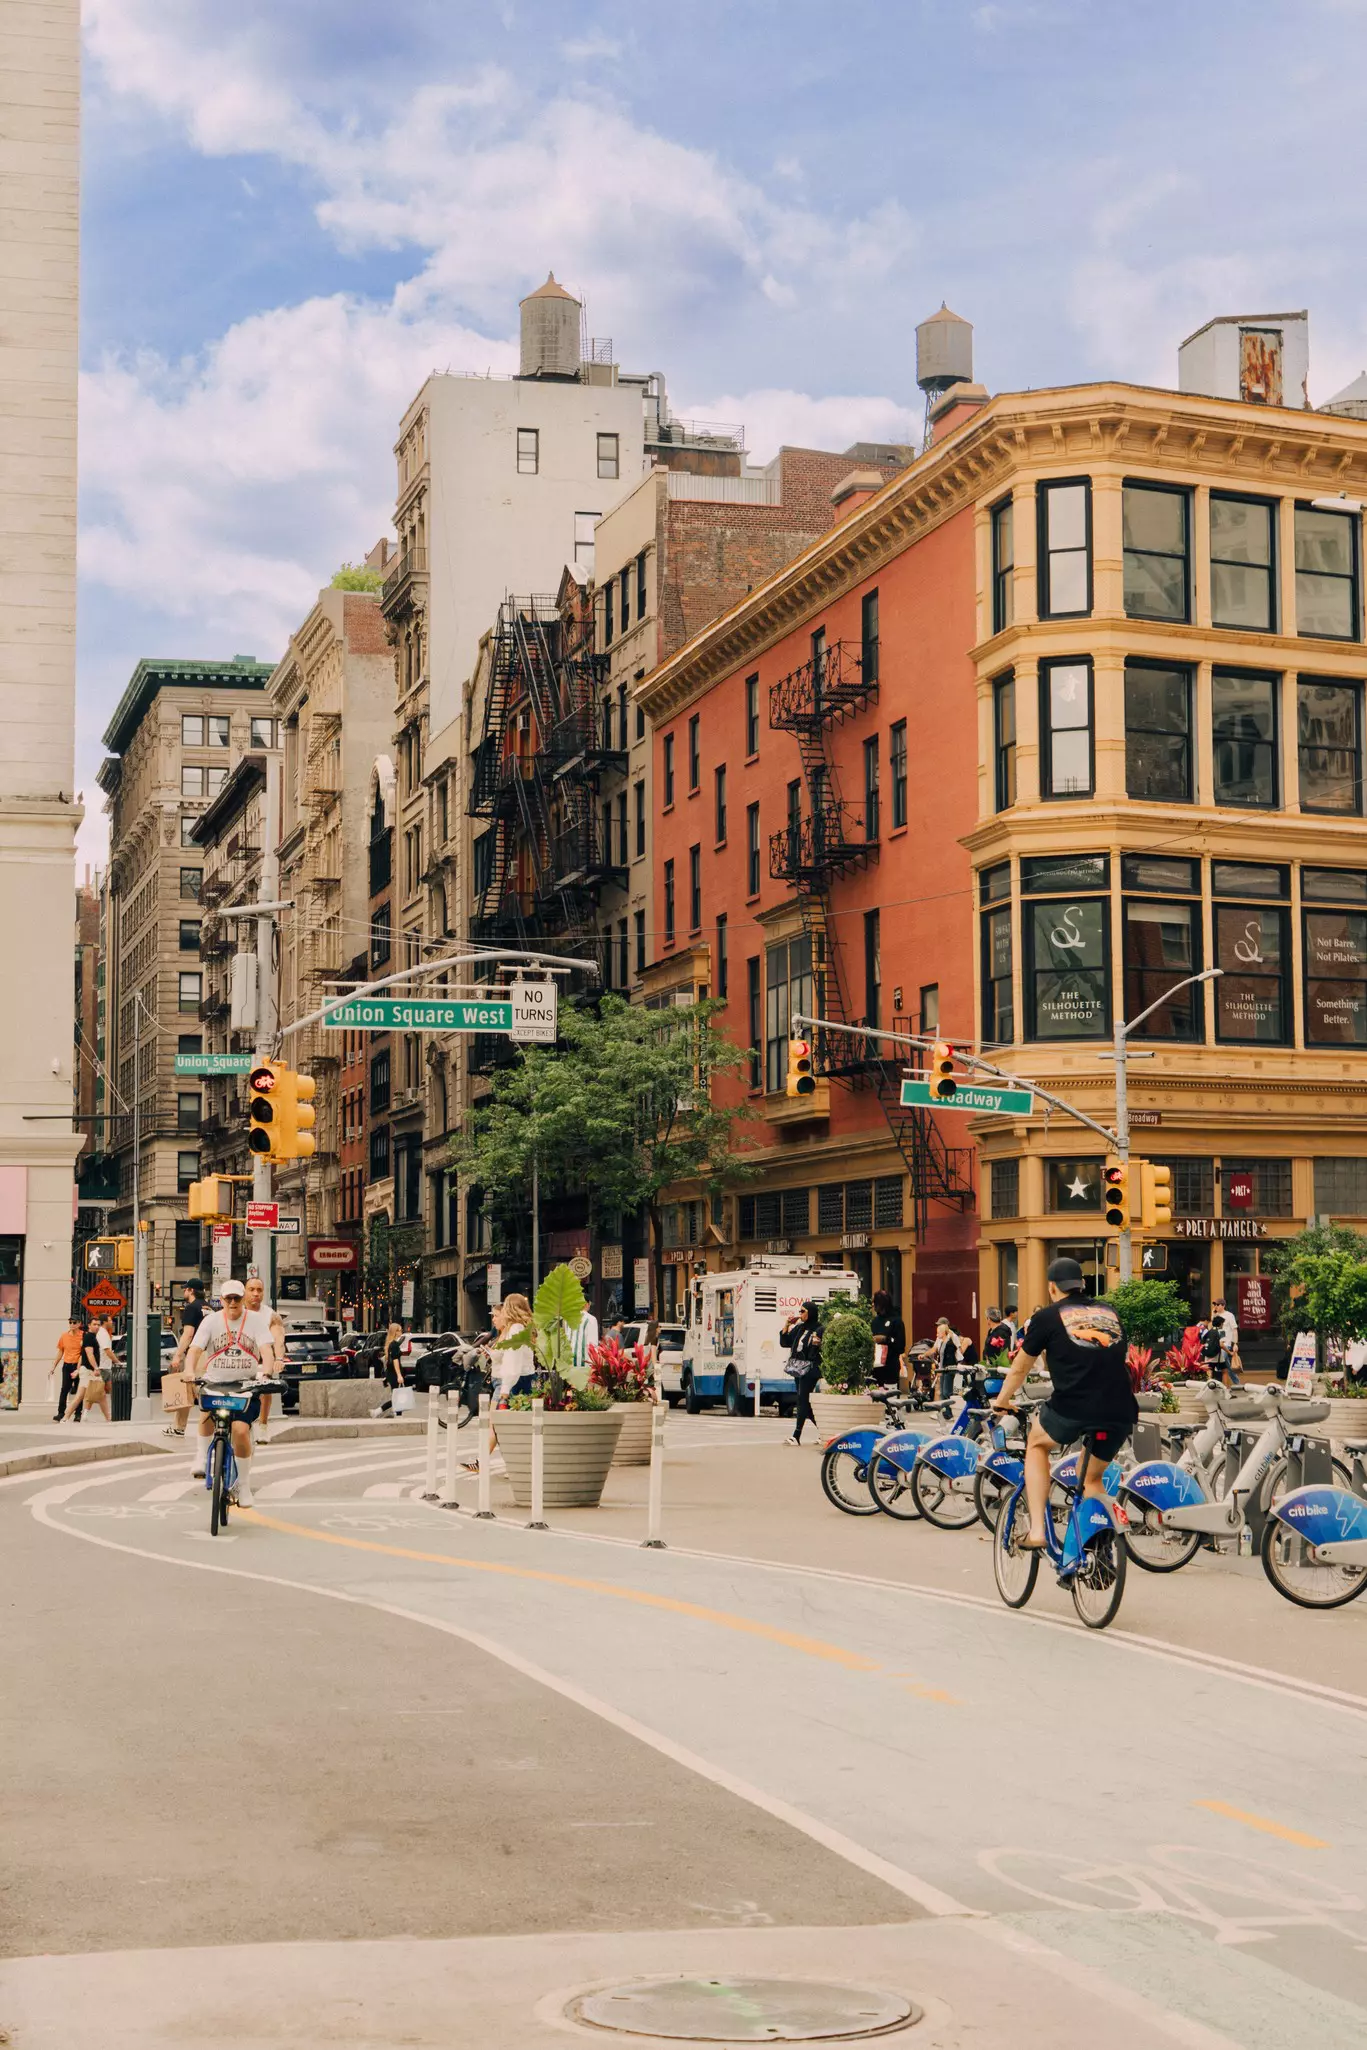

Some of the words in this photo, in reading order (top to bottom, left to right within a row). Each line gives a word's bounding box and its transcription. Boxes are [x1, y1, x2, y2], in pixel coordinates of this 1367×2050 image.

[1317, 938, 1332, 947] Not
[1333, 938, 1357, 948] Barre.
[1316, 952, 1332, 961] Not
[1333, 953, 1360, 963] Pilates.
[524, 991, 543, 1003] NO
[1061, 992, 1079, 1000] THE
[1042, 1001, 1102, 1011] SILHOUETTE
[1225, 1003, 1273, 1012] SILHOUETTE
[1316, 999, 1359, 1012] Something
[333, 1004, 384, 1021] Union
[393, 1006, 455, 1026] Square
[463, 1008, 506, 1025] West
[515, 1009, 553, 1021] TURNS
[1050, 1010, 1093, 1020] METHOD
[1232, 1012, 1266, 1021] METHOD
[1323, 1014, 1350, 1024] Better.
[177, 1056, 209, 1067] Union
[213, 1056, 251, 1069] Square
[1235, 1185, 1247, 1197] PRET
[1186, 1219, 1207, 1236] PRET
[1210, 1221, 1217, 1236] A
[1220, 1219, 1258, 1237] MANGER
[1247, 1280, 1261, 1289] Mix
[1247, 1287, 1261, 1297] and
[1252, 1305, 1266, 1314] two
[212, 1358, 252, 1369] ATHLETICS
